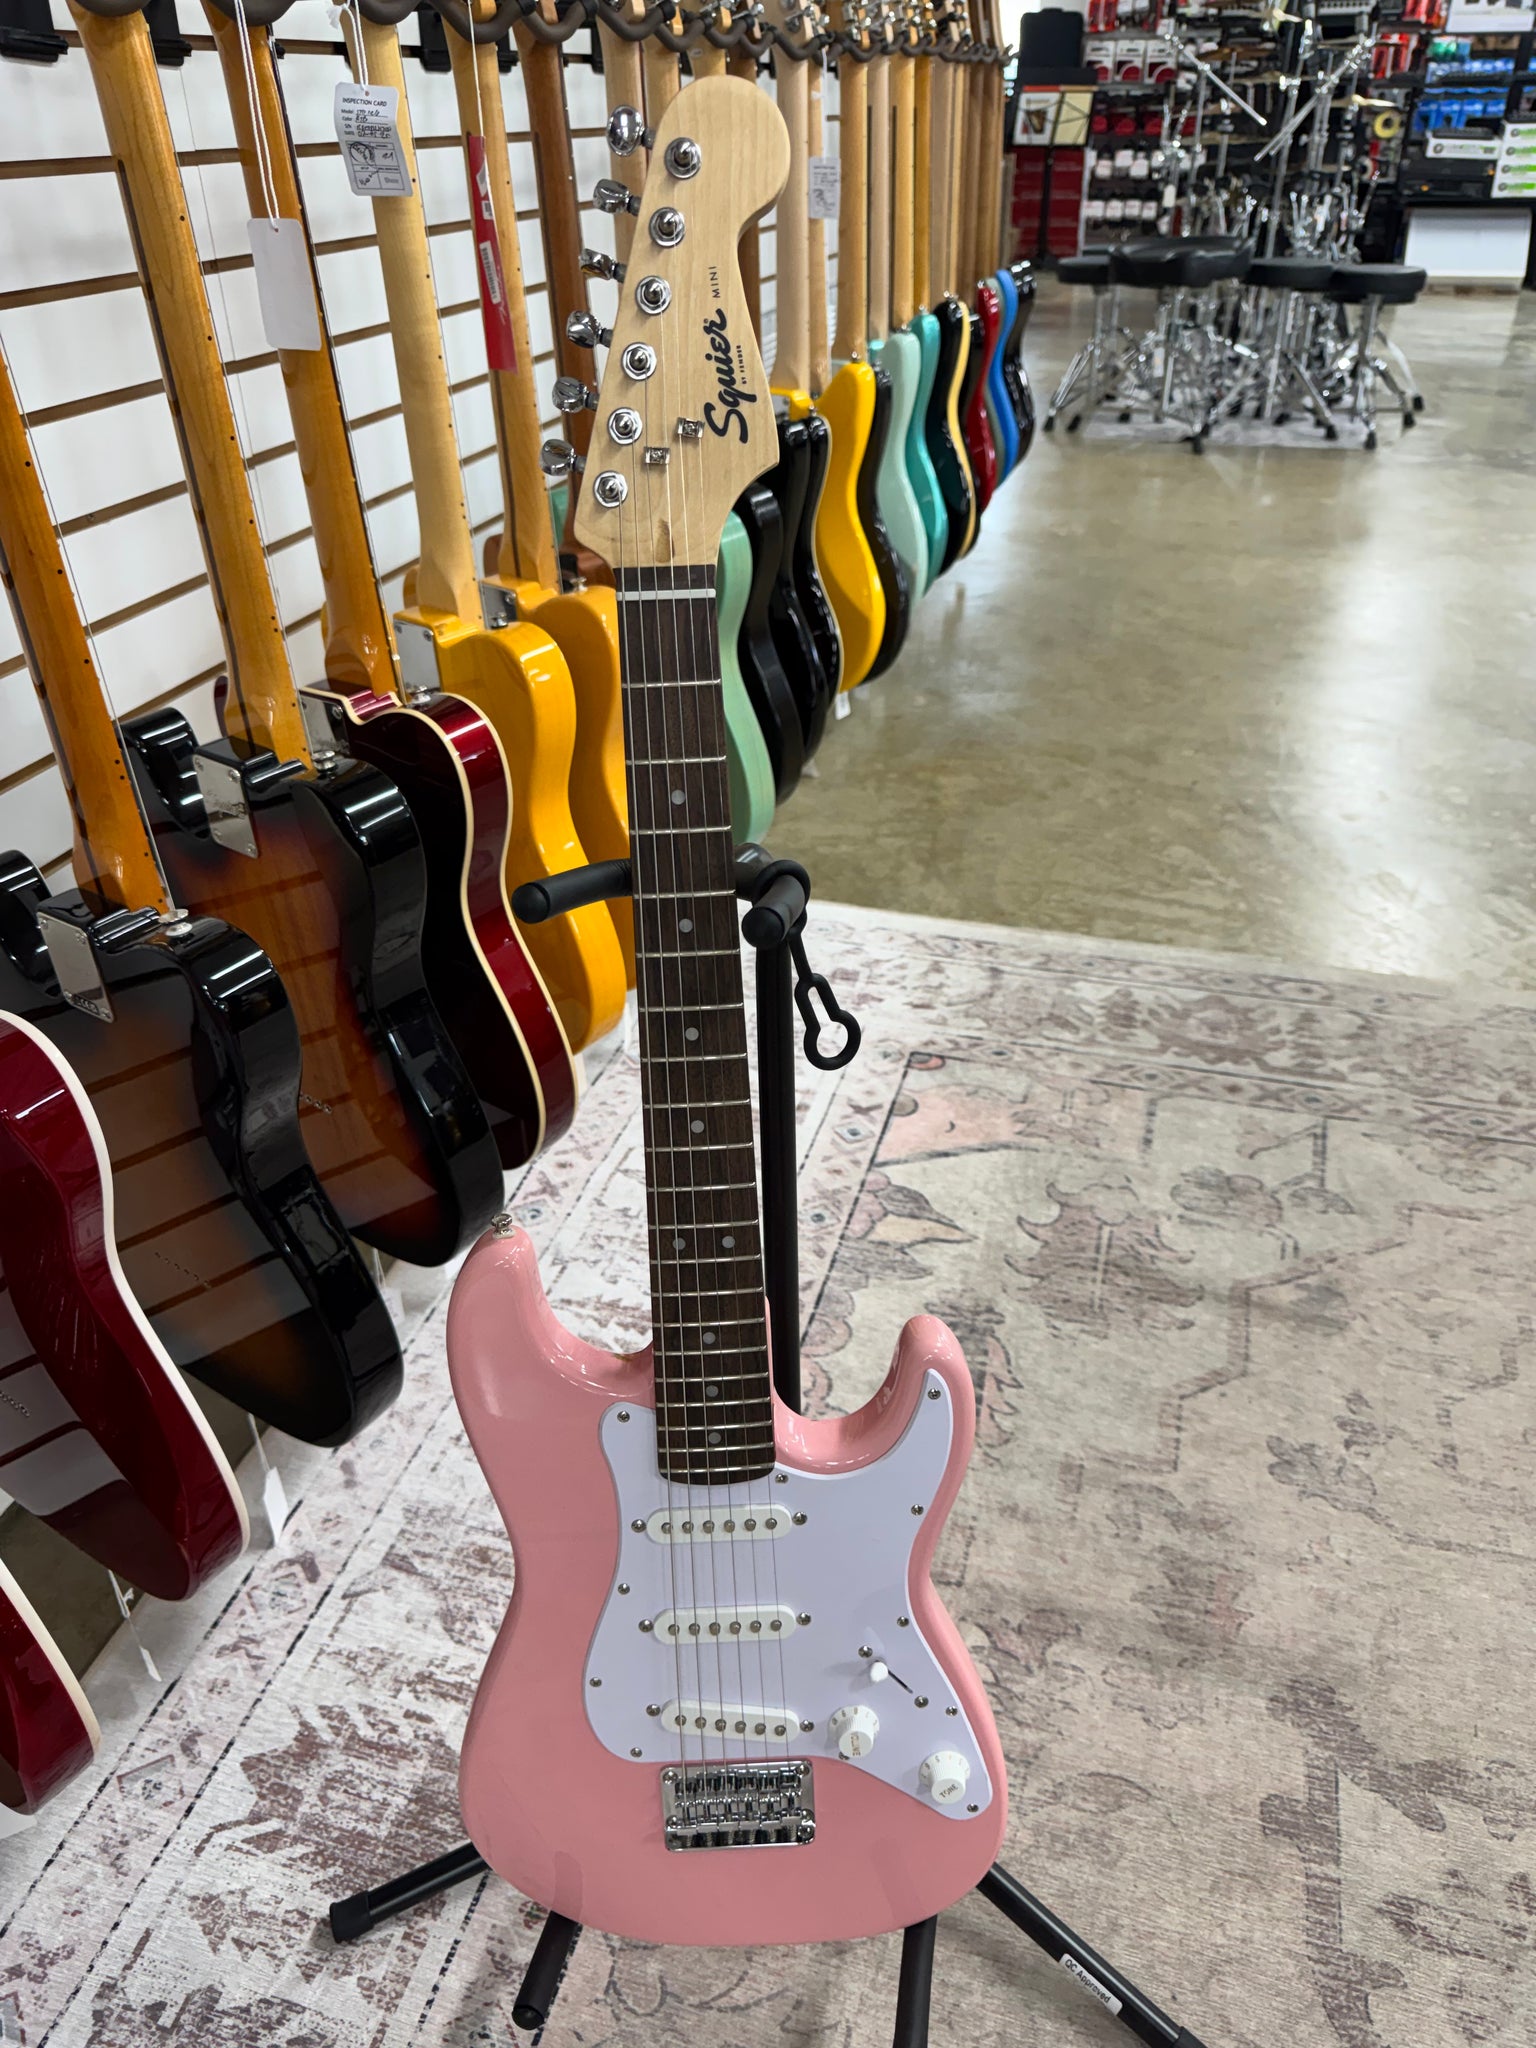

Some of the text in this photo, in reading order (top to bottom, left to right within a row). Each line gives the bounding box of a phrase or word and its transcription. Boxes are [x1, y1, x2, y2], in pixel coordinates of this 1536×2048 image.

[342, 97, 372, 106] INSPECTION
[708, 266, 721, 298] MINI
[736, 344, 745, 373] FENDER
[939, 1783, 959, 1798] TONE
[1065, 1959, 1112, 2003] QC Approved
